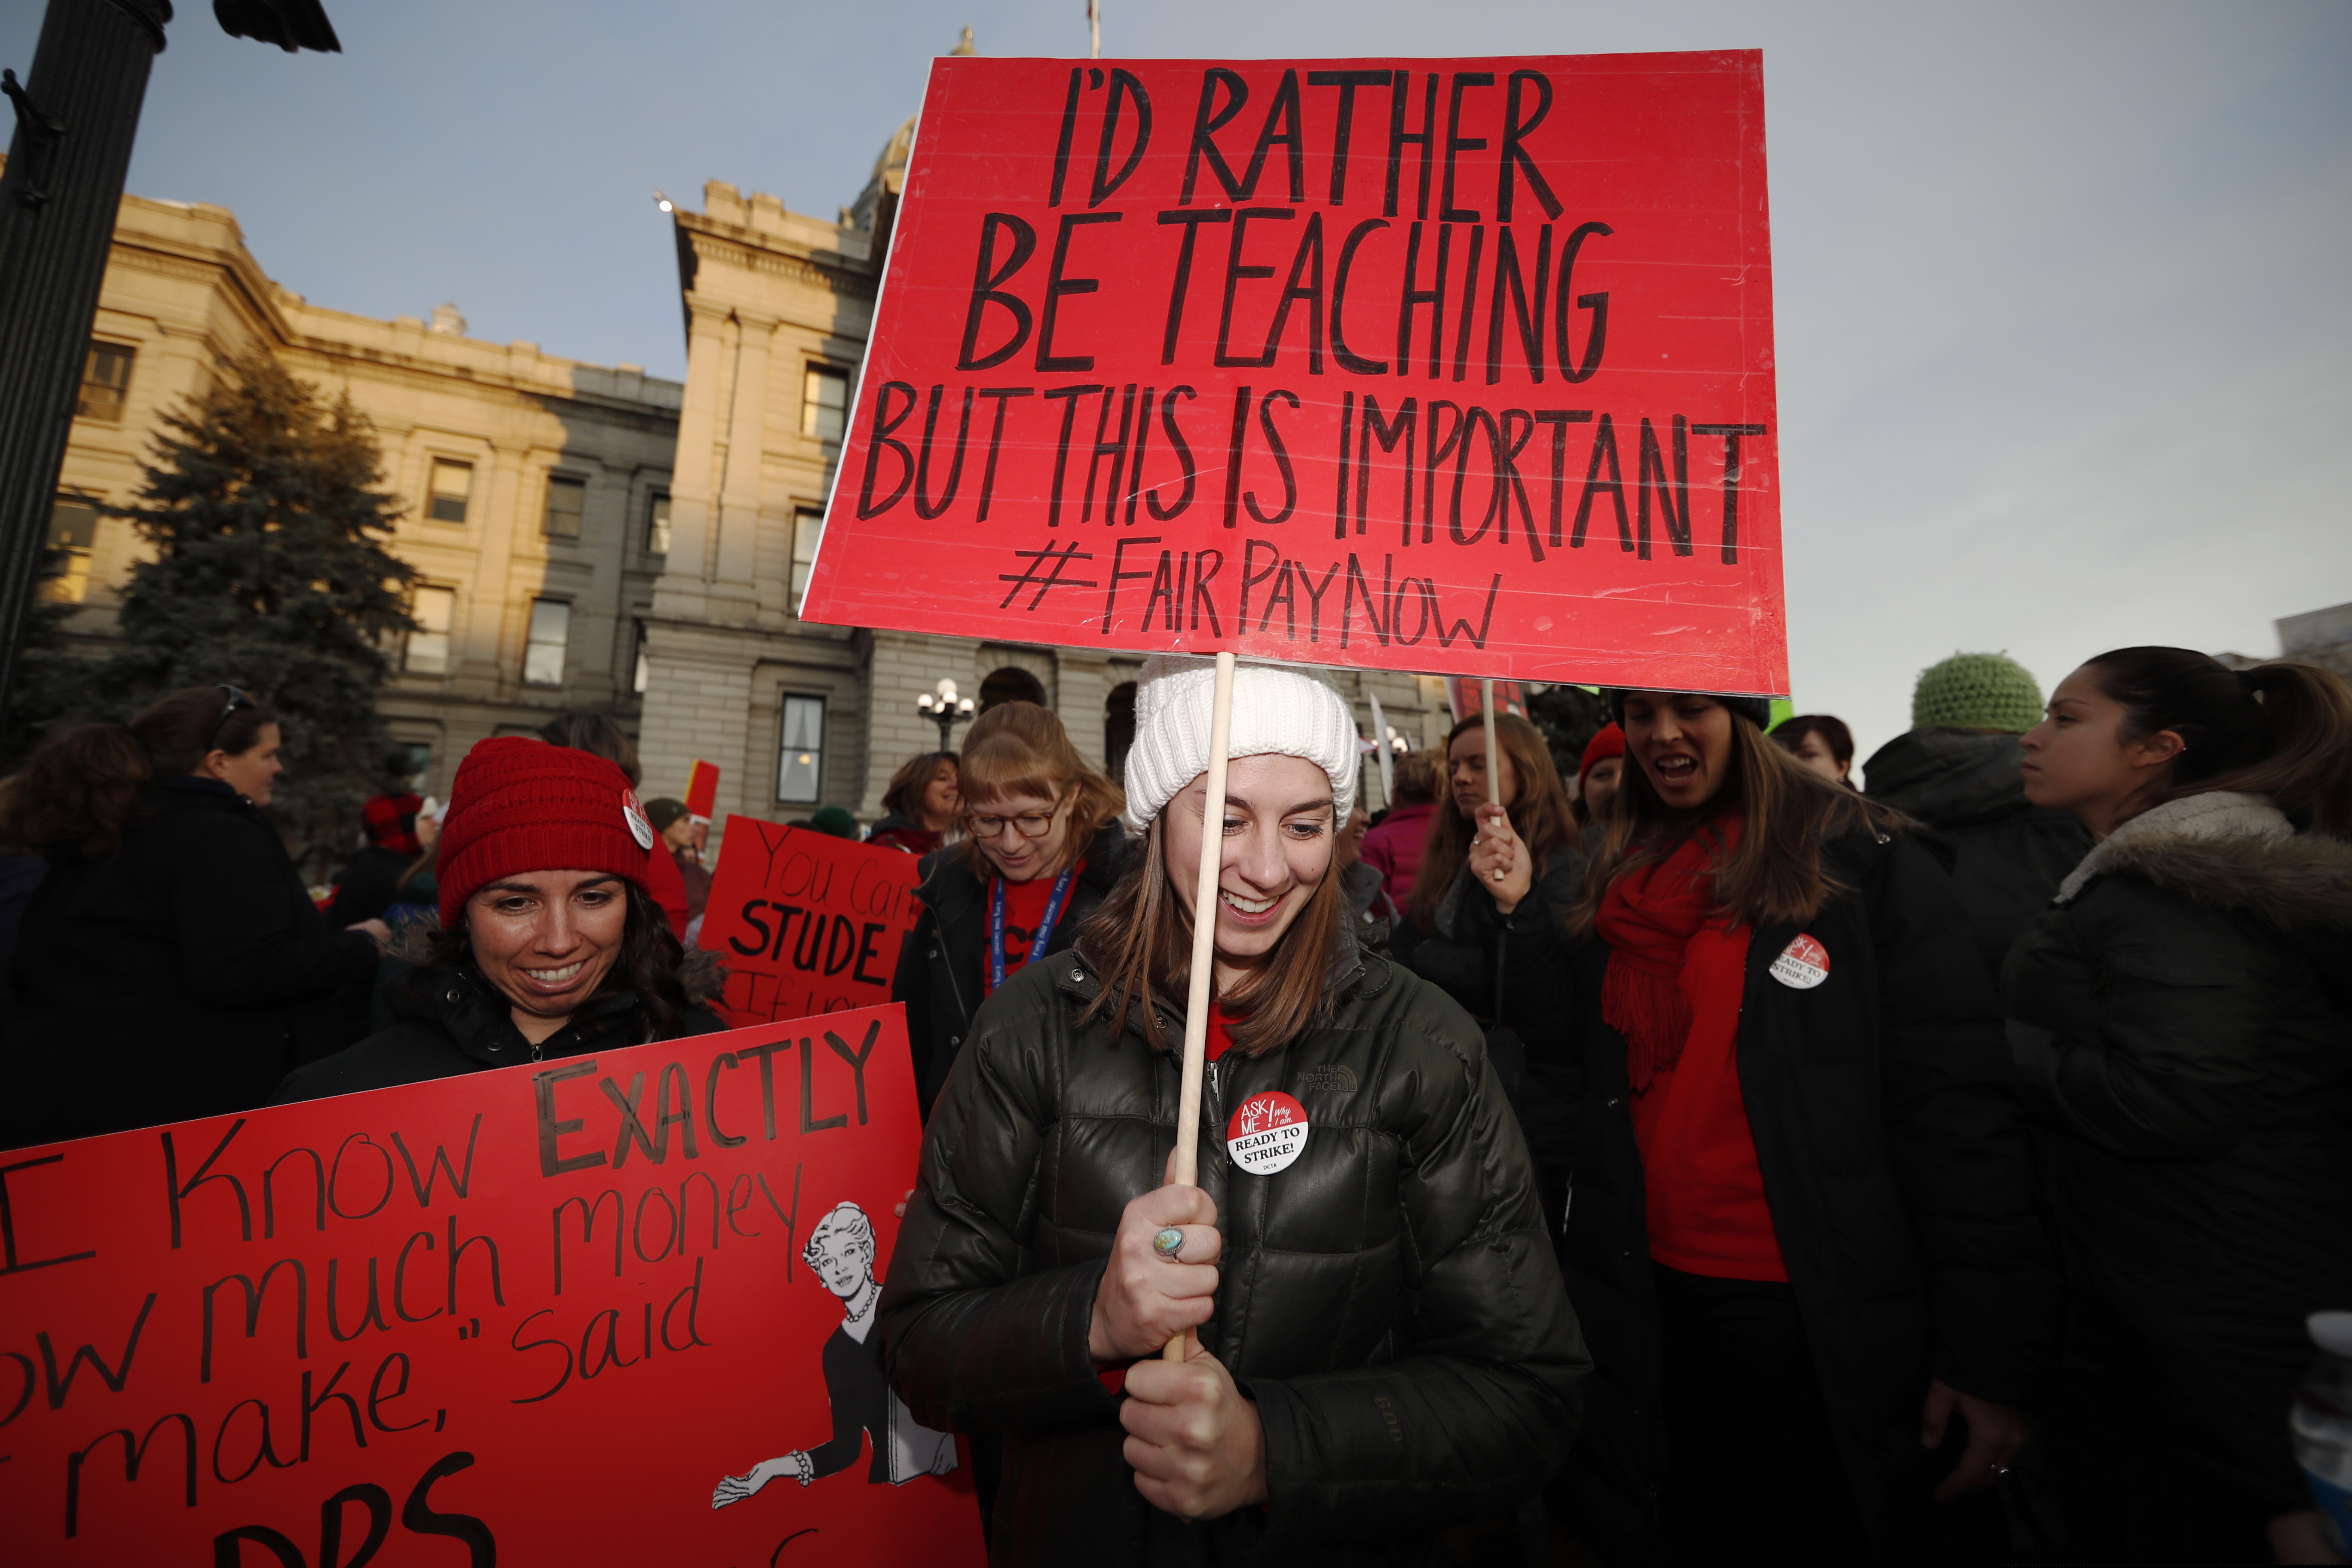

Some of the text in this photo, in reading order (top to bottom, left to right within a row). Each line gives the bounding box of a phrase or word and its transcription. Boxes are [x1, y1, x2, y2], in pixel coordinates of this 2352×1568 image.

[1049, 67, 1564, 223] I'D RATHER
[956, 208, 1614, 385] BE TEACHING
[858, 381, 1767, 565] BUT THIS IS IMPORTANT
[729, 899, 913, 987] STUDE
[1773, 963, 1813, 985] STRIKE!
[1778, 954, 1805, 970] EADY
[1808, 968, 1821, 978] TO
[1296, 1072, 1338, 1082] NORTH
[1309, 1082, 1338, 1090] FACE
[1241, 1099, 1269, 1120] ASK
[1274, 1106, 1292, 1118] Why
[1280, 1117, 1292, 1125] am
[0, 1152, 95, 1275] I
[531, 1019, 881, 1178] EXACTLY
[1235, 1127, 1300, 1152] READY TO
[1244, 1142, 1295, 1164] STRIKE!
[201, 1214, 506, 1385] much
[553, 1162, 802, 1296] money
[214, 1450, 497, 1568] PS
